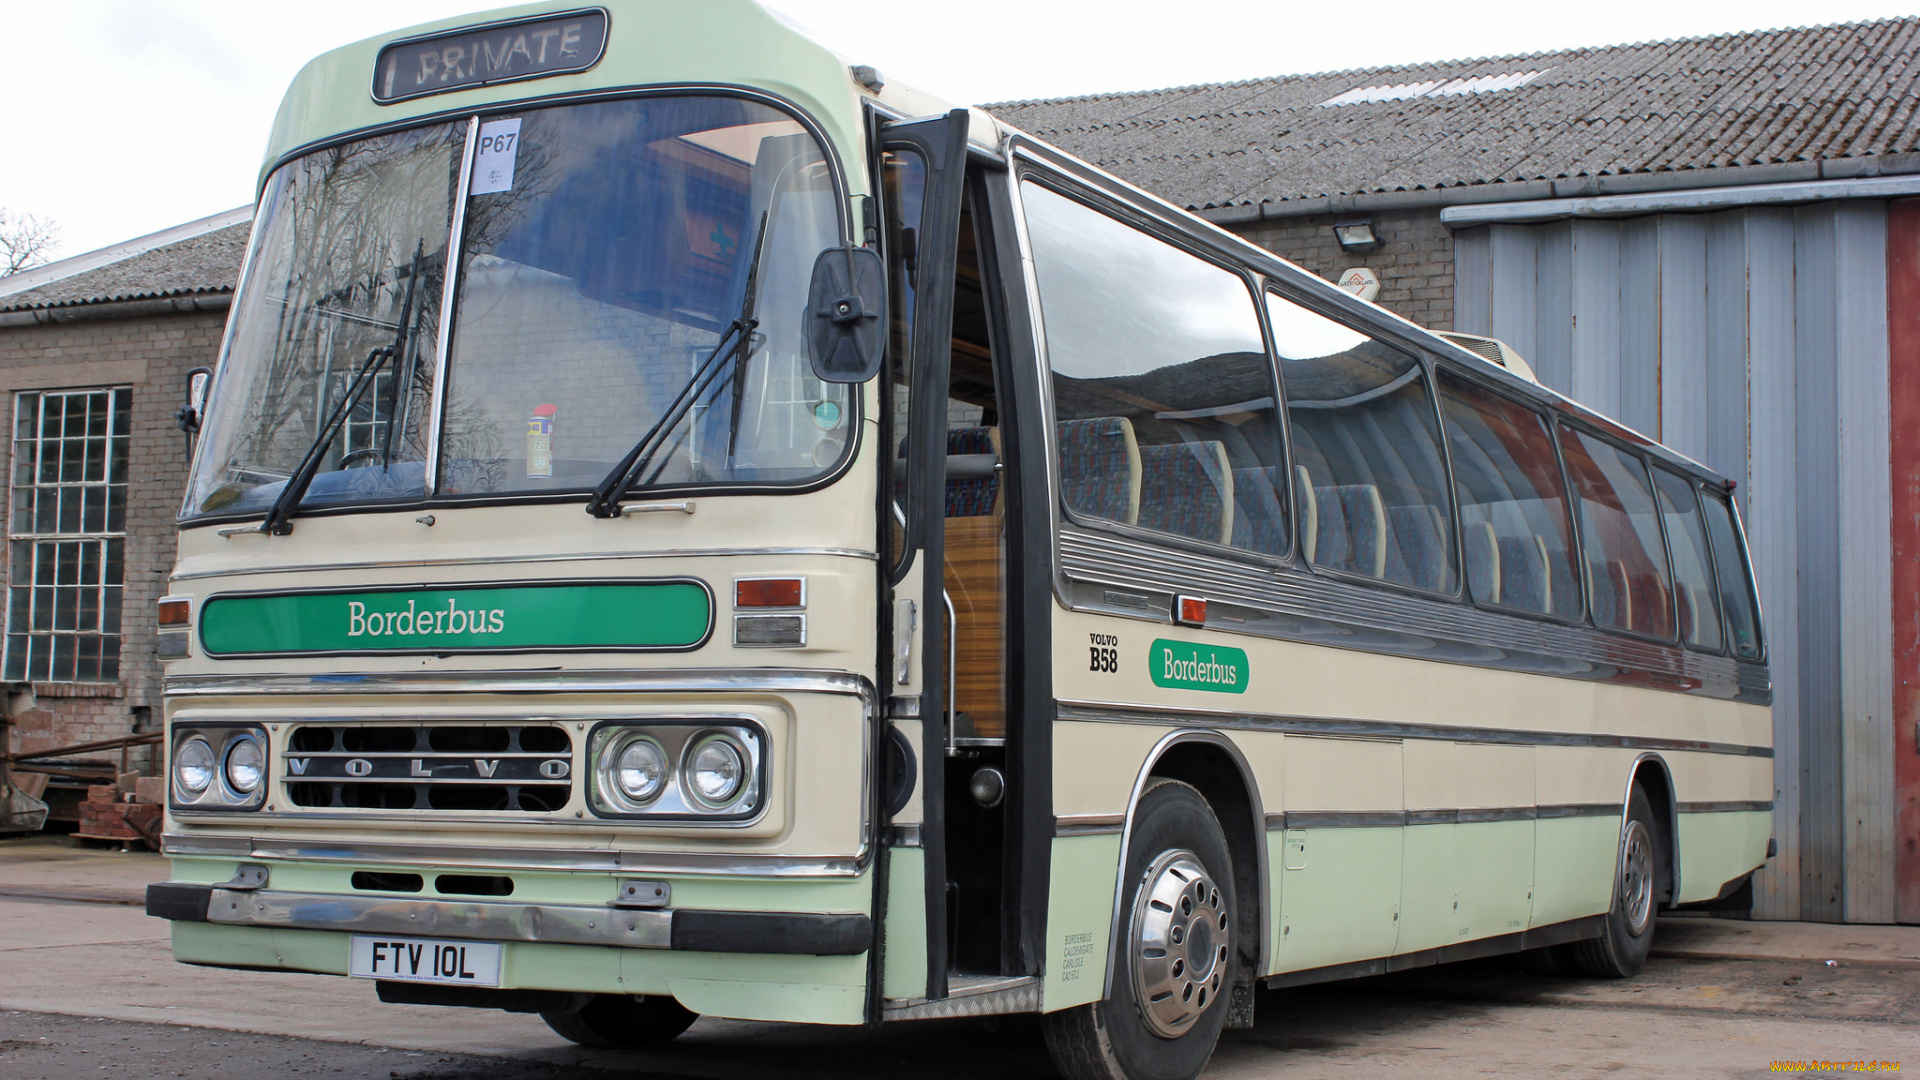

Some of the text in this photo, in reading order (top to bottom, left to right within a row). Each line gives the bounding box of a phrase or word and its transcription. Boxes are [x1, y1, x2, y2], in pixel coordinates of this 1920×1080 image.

[416, 23, 583, 85] PRIVATE
[479, 132, 517, 156] P67
[347, 598, 505, 637] Borderbus
[1089, 633, 1118, 647] VOLVO
[1089, 646, 1118, 674] B58
[1163, 648, 1237, 685] Borderbus
[288, 758, 570, 779] VOLVO
[372, 941, 475, 979] FTV 10L
